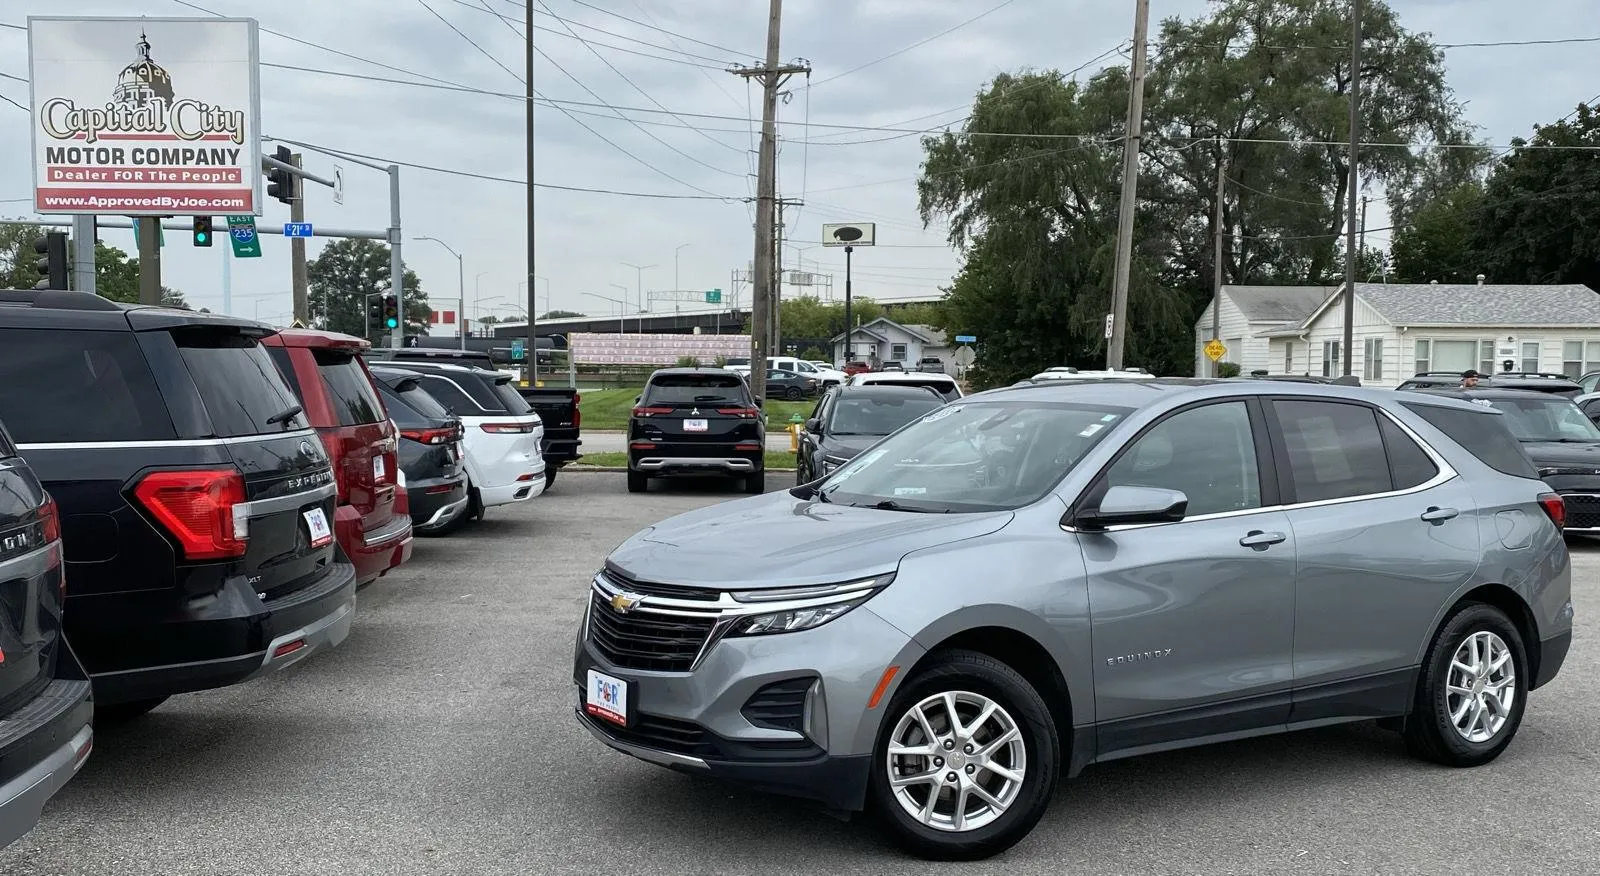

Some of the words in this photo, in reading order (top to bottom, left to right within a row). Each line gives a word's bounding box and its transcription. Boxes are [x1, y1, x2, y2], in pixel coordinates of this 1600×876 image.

[41, 97, 166, 144] Capital
[170, 98, 244, 145] City
[46, 146, 125, 165] MOTOR
[131, 148, 240, 166] COMPANY
[54, 170, 107, 180] Dealer
[114, 171, 143, 181] FOR
[149, 171, 177, 181] The
[182, 171, 236, 184] People
[45, 195, 244, 208] www.ApprovedByJoe.com
[234, 228, 253, 238] 235
[1107, 648, 1171, 666] EQUINOX
